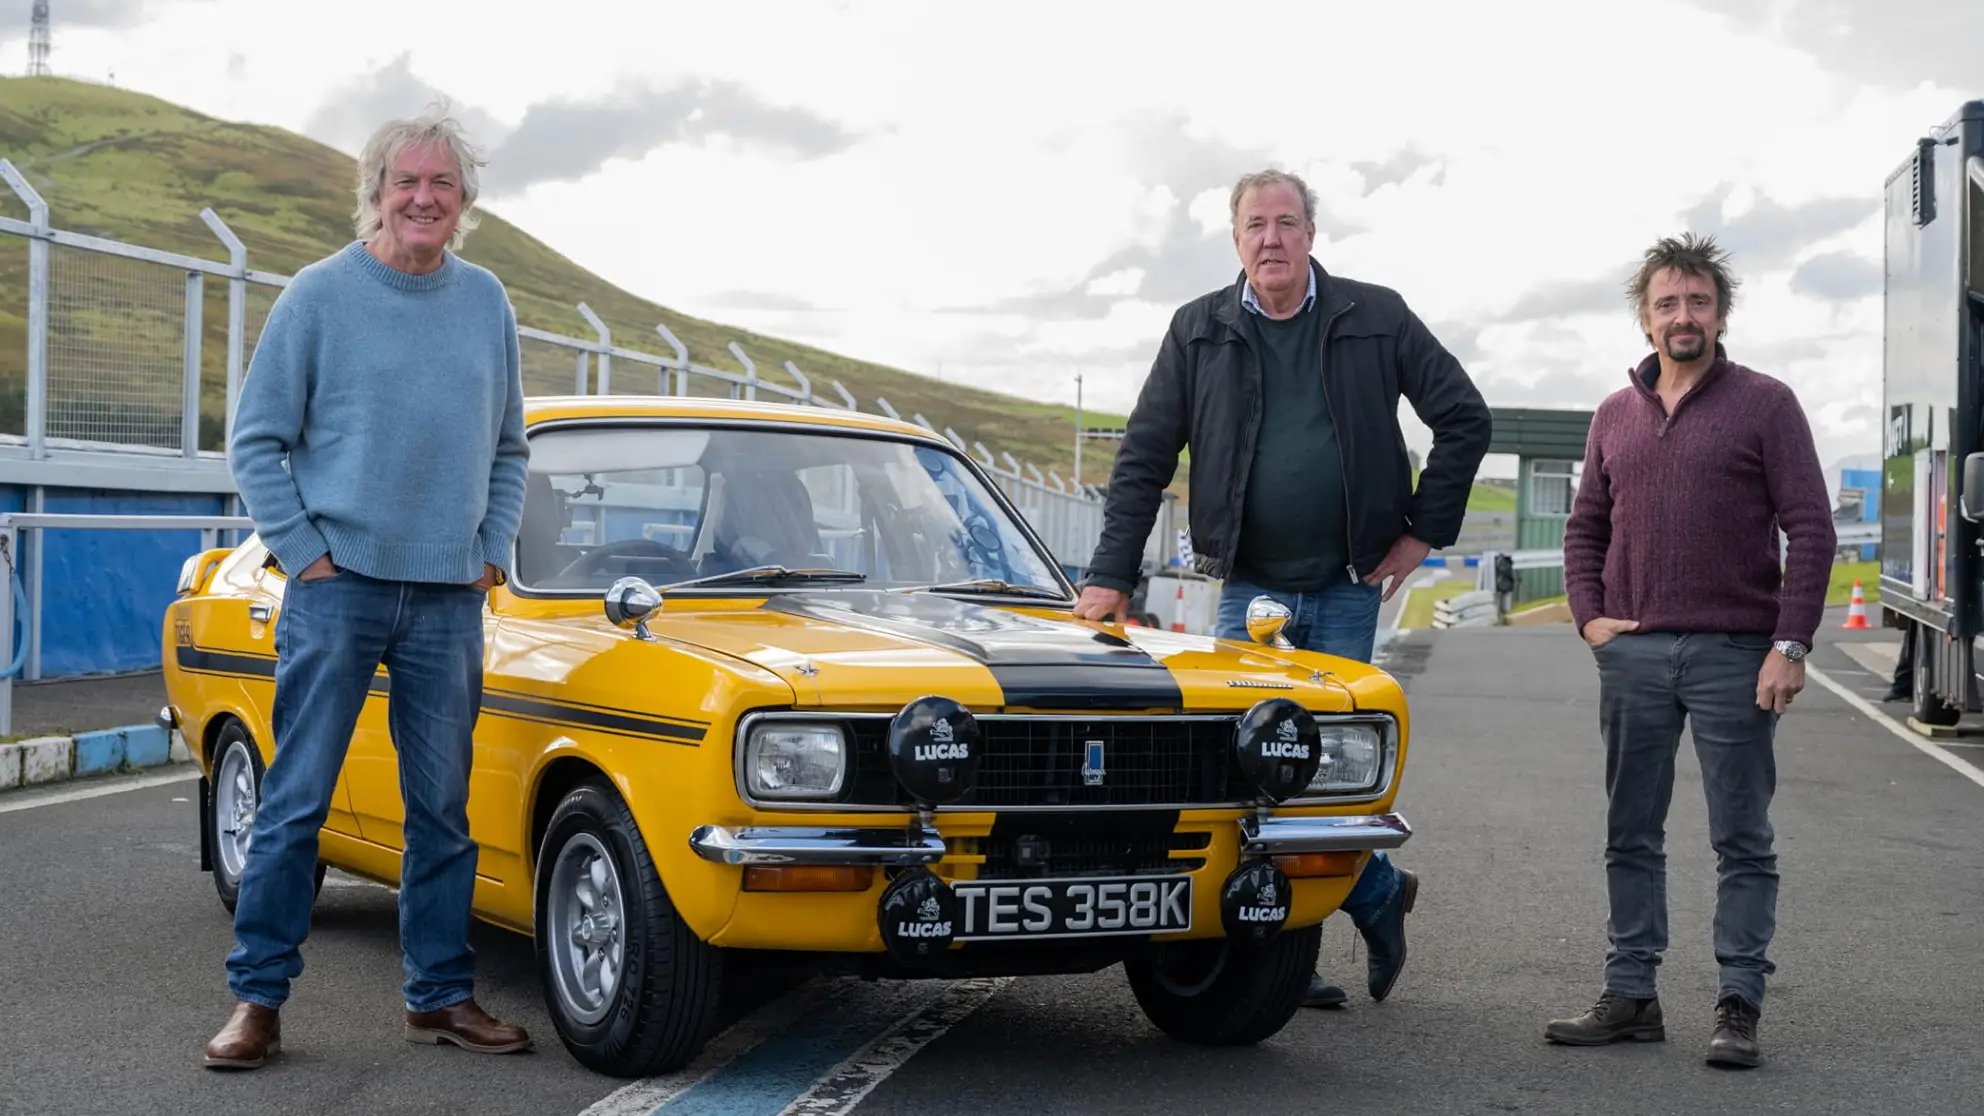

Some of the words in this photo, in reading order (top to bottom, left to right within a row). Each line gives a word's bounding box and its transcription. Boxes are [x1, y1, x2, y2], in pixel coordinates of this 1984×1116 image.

[914, 743, 969, 761] LUCAS
[1261, 742, 1310, 760] LUCAS
[955, 885, 1053, 934] TES
[1065, 881, 1188, 930] 358K
[1238, 905, 1287, 922] LUCAS
[898, 920, 953, 938] LUCAS
